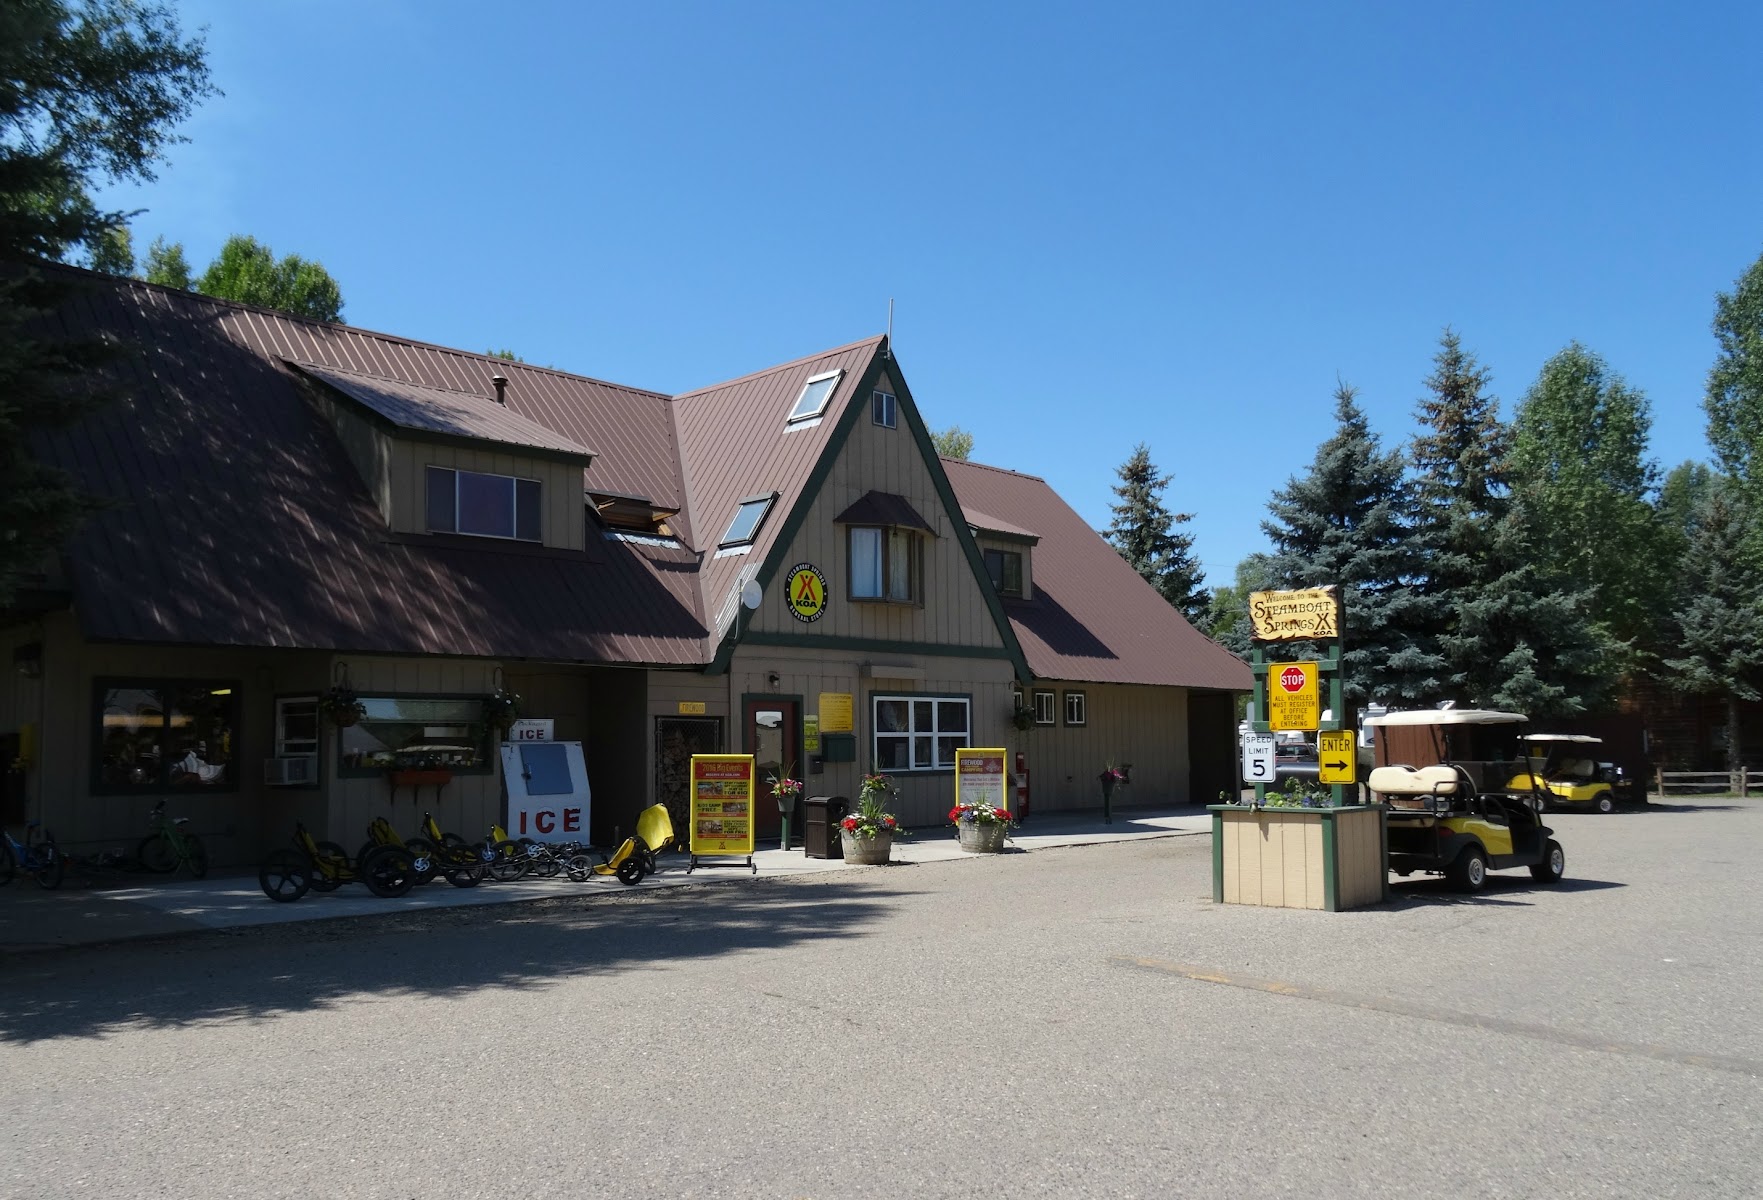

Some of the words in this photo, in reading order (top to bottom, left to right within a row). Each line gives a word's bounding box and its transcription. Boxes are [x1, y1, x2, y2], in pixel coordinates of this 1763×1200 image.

[796, 599, 818, 609] KOA
[1254, 601, 1331, 618] STEAMBOAT
[1263, 617, 1315, 634] SPRINGS
[1281, 674, 1304, 686] STOP
[519, 729, 545, 740] ICE
[1322, 739, 1351, 752] ENTER
[1252, 759, 1266, 777] 5
[520, 807, 581, 835] ICE
